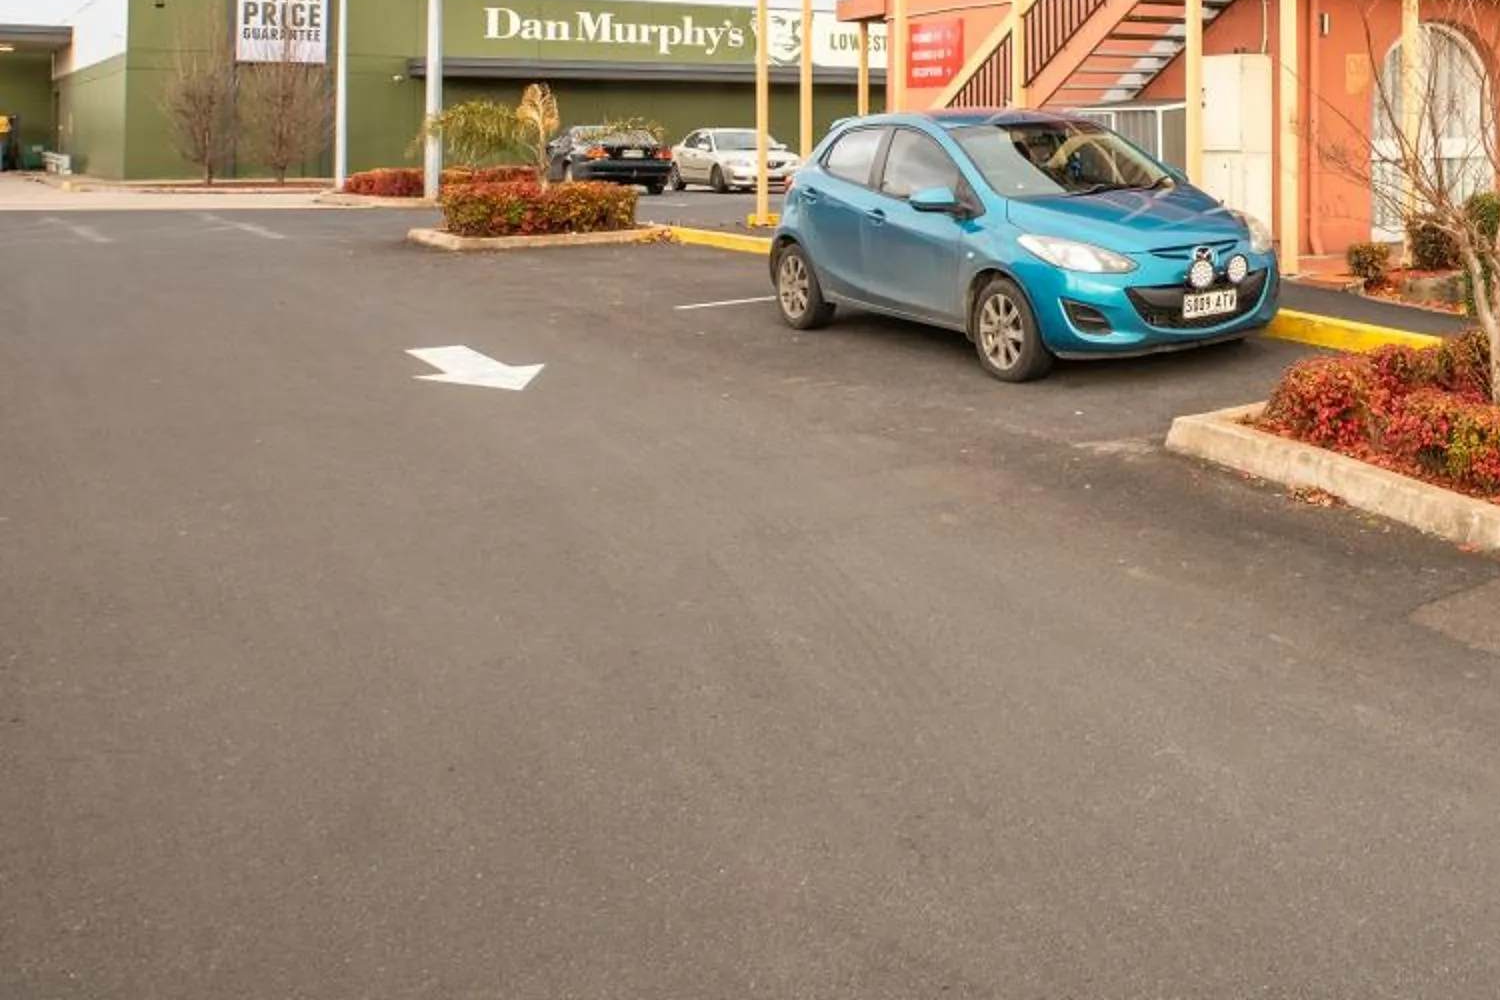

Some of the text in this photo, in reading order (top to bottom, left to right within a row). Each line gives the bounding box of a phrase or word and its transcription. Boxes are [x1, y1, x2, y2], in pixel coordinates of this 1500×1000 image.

[243, 1, 321, 28] PRICE
[483, 7, 745, 55] Dan Murphy's
